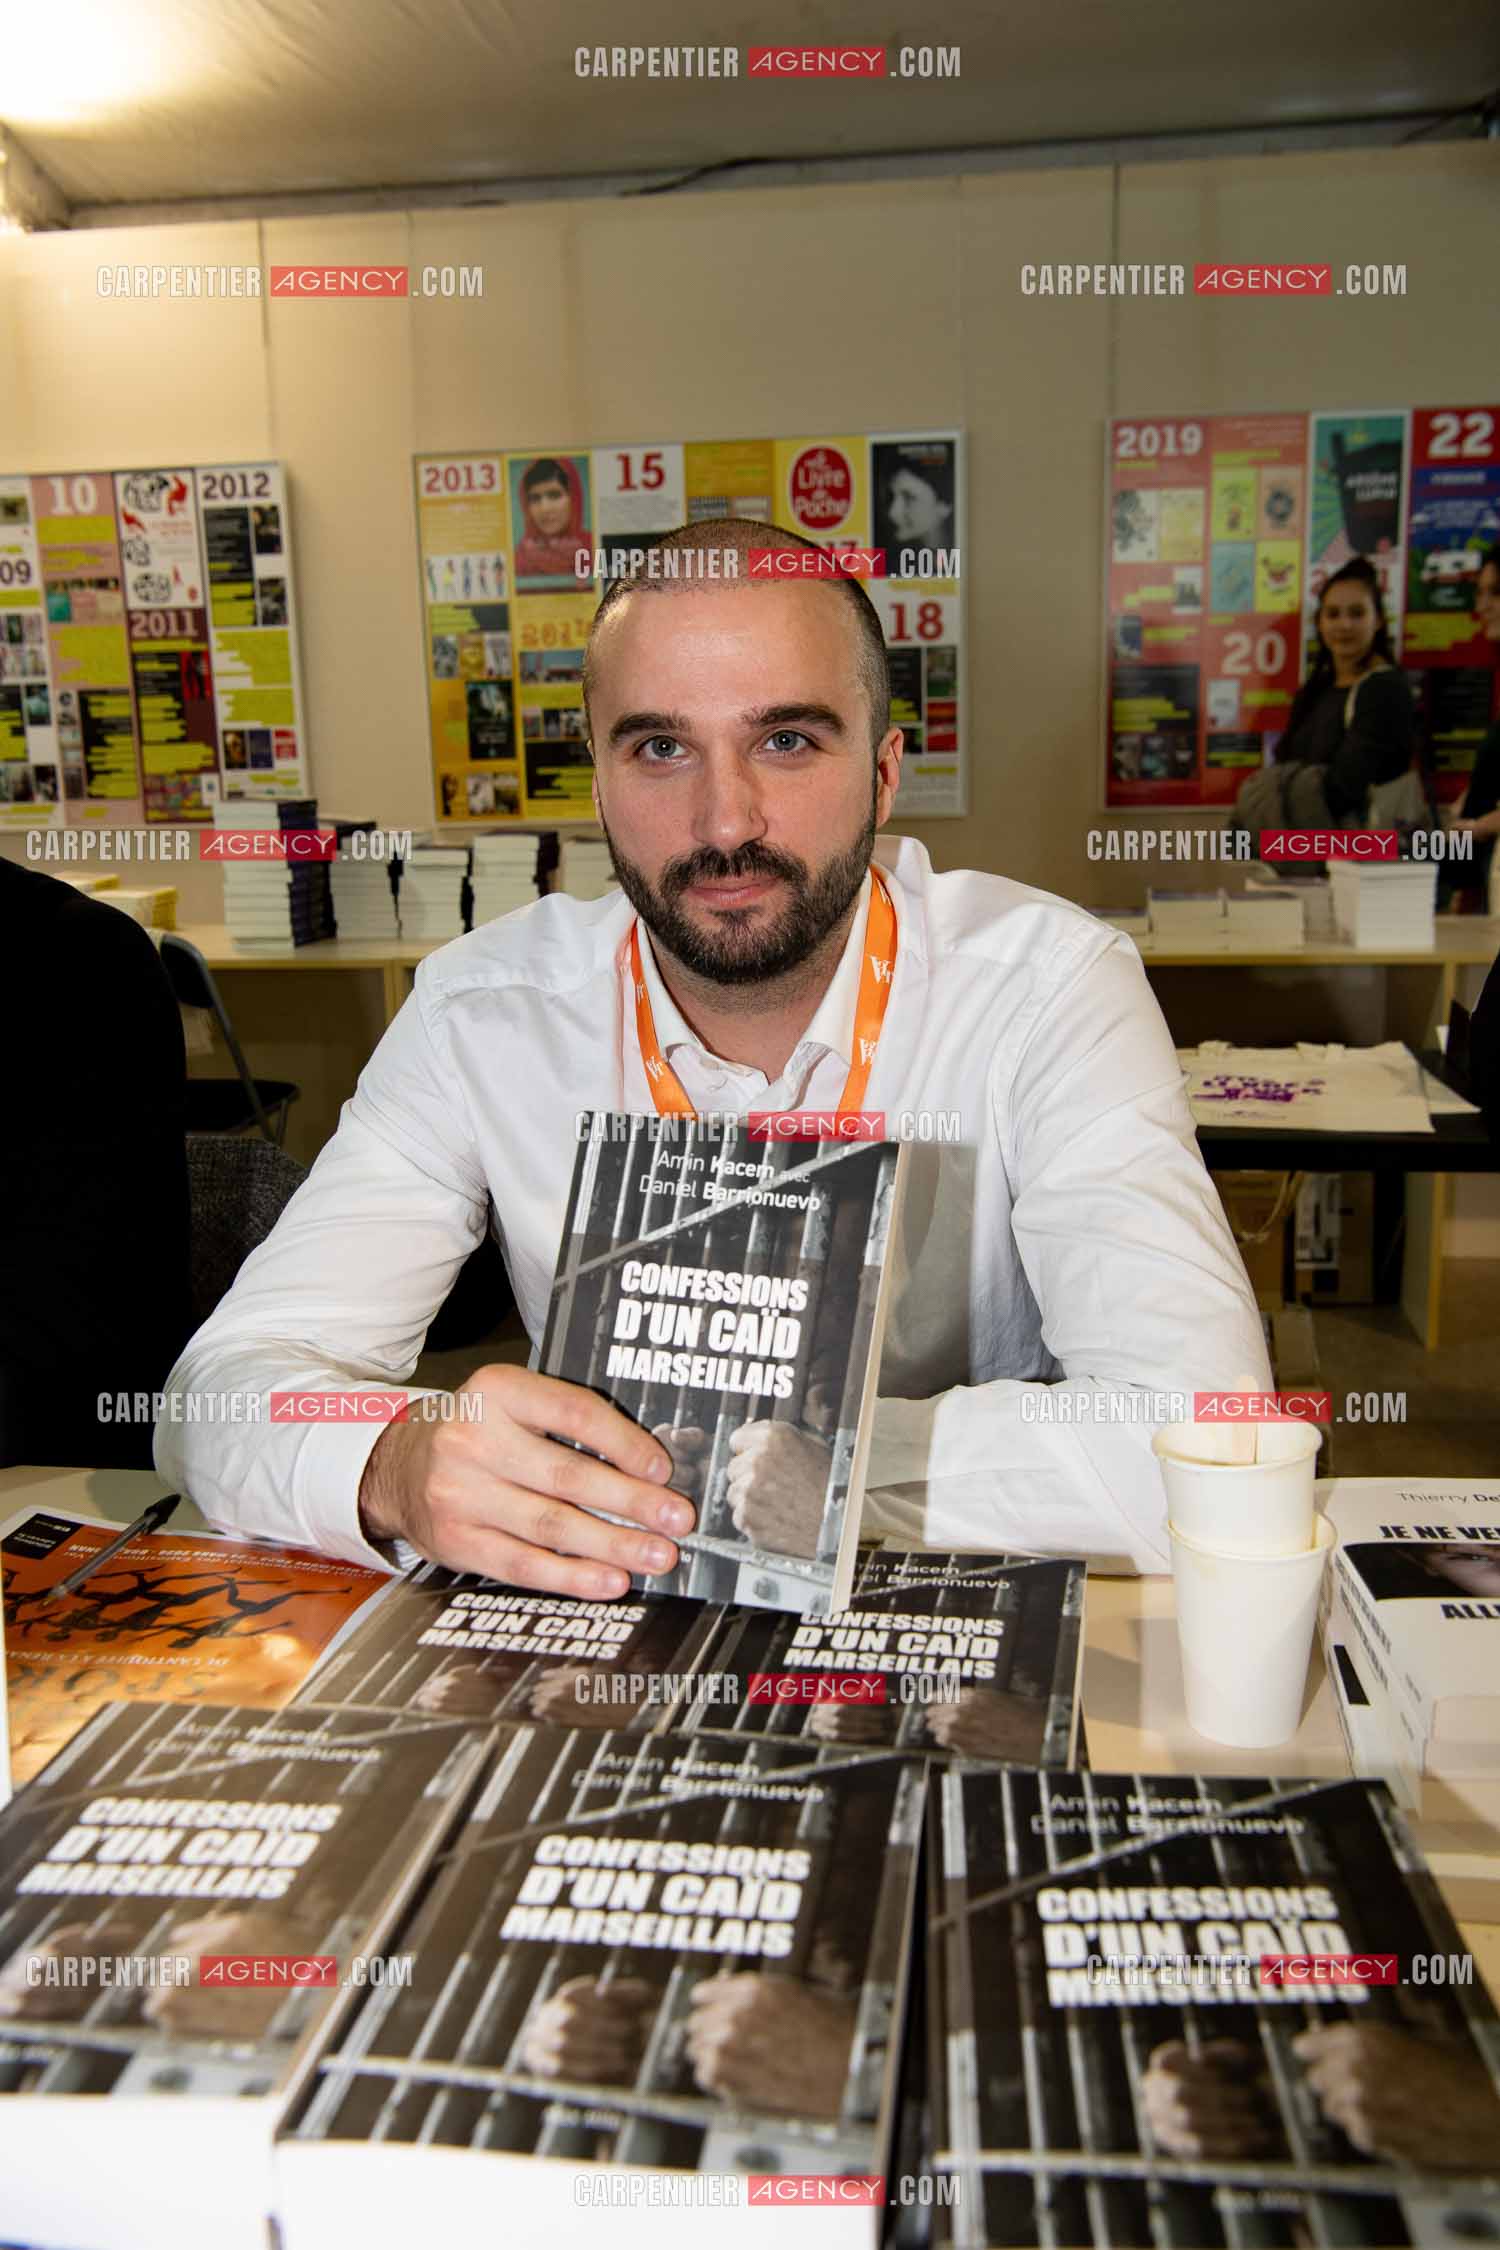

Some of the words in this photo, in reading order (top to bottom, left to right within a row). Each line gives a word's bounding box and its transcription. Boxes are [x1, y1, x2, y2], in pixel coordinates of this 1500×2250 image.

[1116, 424, 1203, 457] 2019
[1427, 412, 1495, 459] 22
[203, 473, 270, 500] 2012
[424, 463, 497, 493] 2013
[616, 452, 665, 491] 15
[51, 477, 98, 514] 10
[131, 612, 198, 638] 2011
[888, 602, 944, 641] 18
[1222, 631, 1286, 675] 20
[656, 1150, 705, 1172] Amin
[709, 1155, 775, 1179] Kacem
[639, 1174, 697, 1198] Daniel
[702, 1182, 821, 1211] Barrionuevo
[620, 1260, 809, 1311] CONFESSIONS
[613, 1298, 702, 1348] D'UN
[707, 1307, 801, 1359] CAÏD
[606, 1345, 796, 1398] MARSEILLAIS
[1395, 1492, 1468, 1505] Thierry
[1472, 1493, 1500, 1503] De
[1379, 1525, 1412, 1539] JE
[1412, 1526, 1456, 1540] NE
[886, 1575, 1011, 1590] Barrionuevo
[893, 1562, 960, 1576] Kacem
[450, 1592, 648, 1622] CONFESSIONS
[800, 1611, 1005, 1637] CONFESSIONS
[432, 1608, 531, 1634] D'UN
[532, 1616, 635, 1643] CAÏD
[792, 1626, 890, 1653] D'UN
[897, 1632, 1000, 1660] CAÏD
[416, 1628, 623, 1660] MARSEILLAIS
[783, 1648, 997, 1679] MARSEILLAIS
[671, 1756, 760, 1779] Kacem
[659, 1775, 825, 1802] Barrionuevo
[1050, 1795, 1121, 1813] Amin
[1126, 1795, 1223, 1815] Kacem
[80, 1796, 343, 1833] CONFESSIONS
[1126, 1815, 1305, 1836] Barrionuevo
[46, 1825, 186, 1863] D'UN
[179, 1827, 321, 1868] CAÏD
[534, 1835, 812, 1881] CONFESSIONS
[16, 1861, 298, 1900] MARSEILLAIS
[516, 1865, 655, 1912] D'UN
[660, 1872, 803, 1921] CAÏD
[1036, 1885, 1340, 1922] CONFESSIONS
[499, 1904, 795, 1959] MARSEILLAIS
[1042, 1920, 1187, 1968] D'UN
[1196, 1917, 1353, 1967] CAÏD
[1046, 1968, 1371, 2009] MARSEILLAIS
